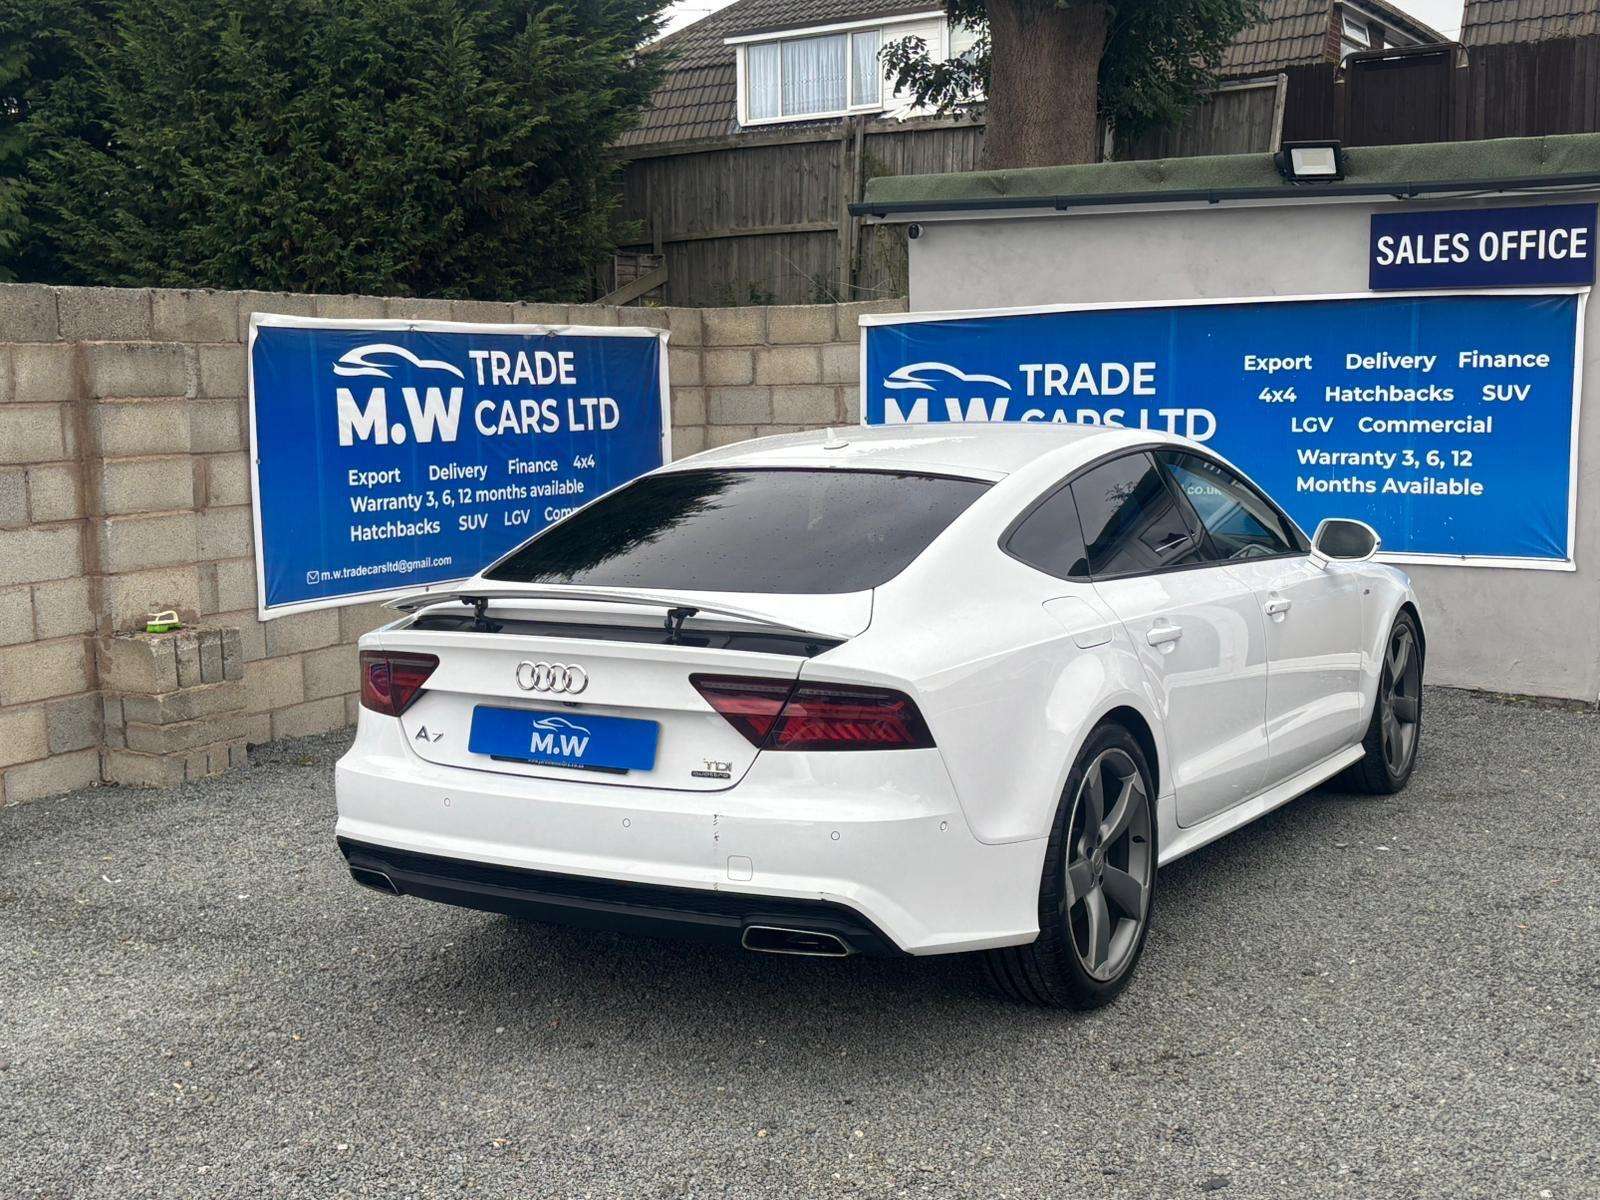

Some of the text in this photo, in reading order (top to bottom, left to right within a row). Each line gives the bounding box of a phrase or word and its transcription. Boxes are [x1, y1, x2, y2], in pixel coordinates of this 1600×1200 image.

[1377, 228, 1587, 265] SALES OFFICE
[469, 351, 576, 385] TRADE
[1245, 350, 1549, 373] Export Delivery Finance
[1019, 362, 1156, 396] TRADE
[1259, 385, 1530, 402] 4x4 Hatchbacks SUV
[337, 387, 463, 446] M.W
[475, 398, 619, 436] CARS LTD
[1140, 408, 1217, 442] LTD
[1292, 415, 1492, 433] LGV Commercial
[349, 455, 595, 488] Export Delivery Finance 4x4
[1297, 449, 1472, 469] Warranty 3, 6, 12
[350, 480, 585, 513] Warranty 3, 6, 12 months available
[1297, 477, 1483, 495] Months Available
[351, 518, 440, 541] Hatchbacks
[459, 514, 488, 530] SUV
[505, 509, 530, 525] LGV
[530, 731, 589, 758] M.W
